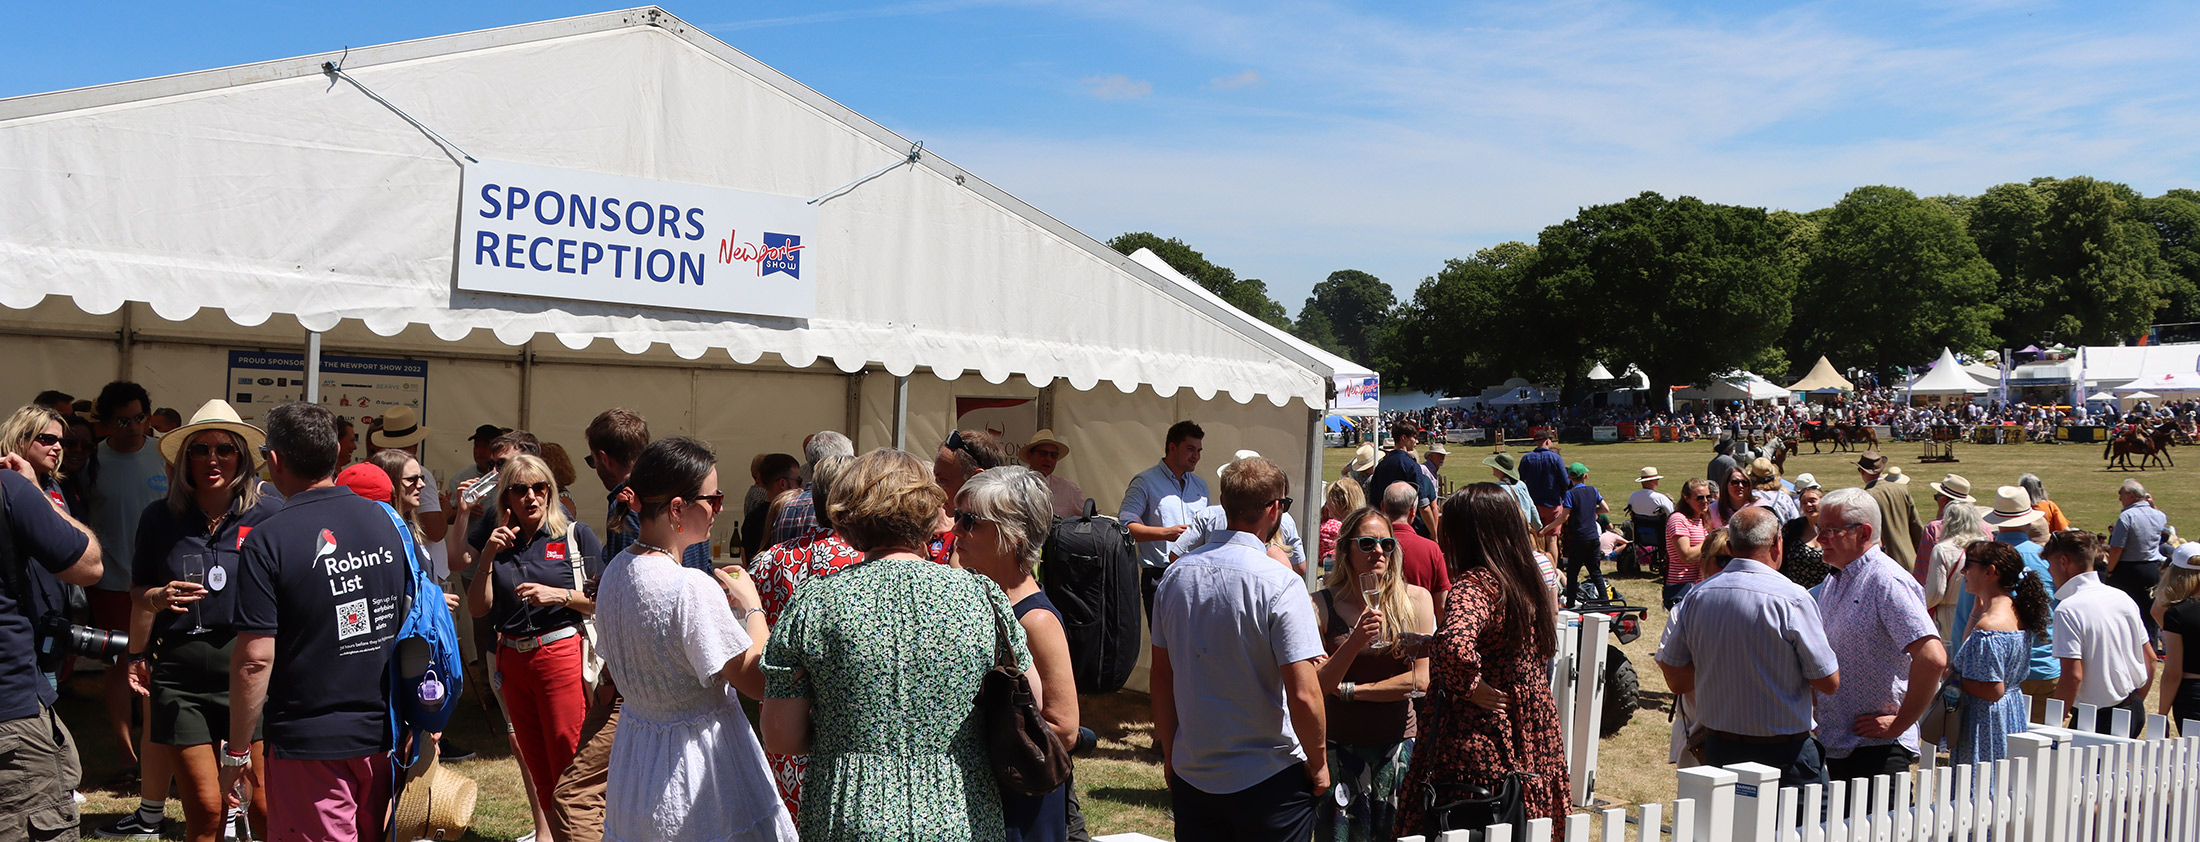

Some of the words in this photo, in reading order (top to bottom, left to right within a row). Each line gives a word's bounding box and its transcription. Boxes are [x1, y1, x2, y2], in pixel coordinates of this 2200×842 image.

[479, 183, 705, 241] SPONSORS
[475, 230, 705, 286] RECEPTION
[718, 229, 805, 277] Newport
[766, 259, 797, 271] SHOW
[238, 356, 266, 364] PROUD
[268, 358, 304, 366] SPONSOR
[324, 361, 339, 369] THE
[340, 362, 378, 370] NEWPORT
[379, 364, 402, 372] SHOW
[404, 365, 422, 373] 2022
[1344, 379, 1380, 402] Newport
[324, 546, 394, 576] Robin's
[329, 575, 363, 596] List
